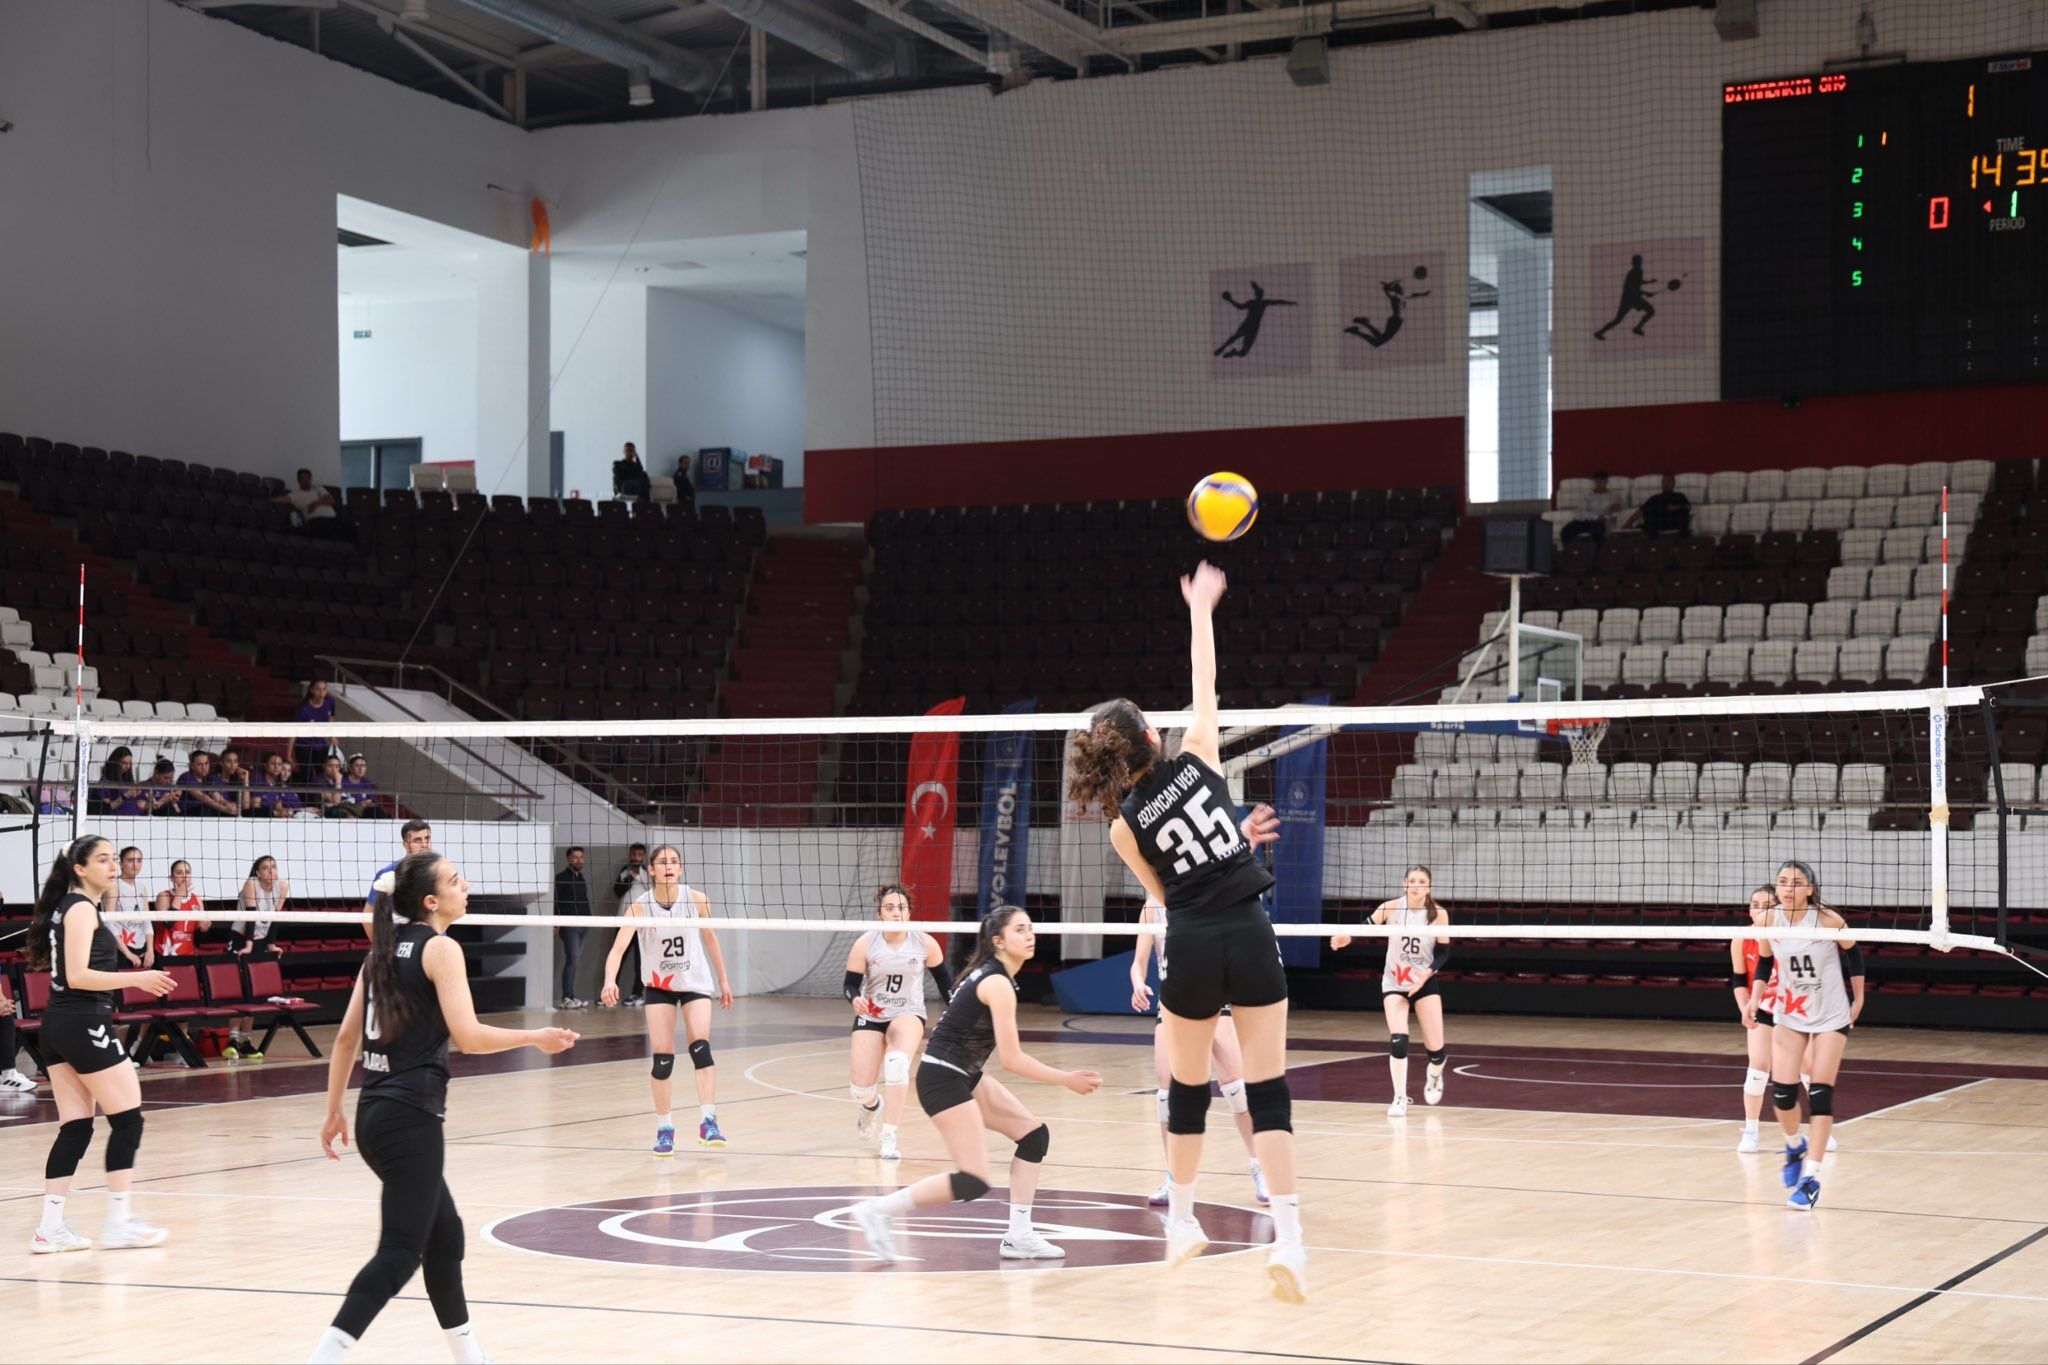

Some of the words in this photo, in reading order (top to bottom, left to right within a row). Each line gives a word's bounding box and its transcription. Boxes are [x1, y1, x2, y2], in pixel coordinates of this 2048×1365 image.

[1967, 84, 1975, 118] 1
[1996, 137, 2025, 151] TIME
[1851, 168, 1863, 183] 2
[1852, 202, 1863, 218] 3
[1929, 197, 1949, 229] 0
[2010, 190, 2018, 218] 1
[1989, 216, 2026, 232] PERIOD
[1852, 236, 1863, 251] 4
[1852, 271, 1863, 286] 5
[1137, 783, 1183, 830] ERZİNCAN
[1173, 763, 1201, 792] VEFA
[1155, 785, 1240, 875] 35
[990, 781, 1019, 909] VOLEYBOL
[396, 942, 415, 958] EFA
[662, 936, 685, 957] 29
[1401, 936, 1421, 954] 26
[1790, 955, 1816, 978] 44
[886, 974, 903, 993] 19
